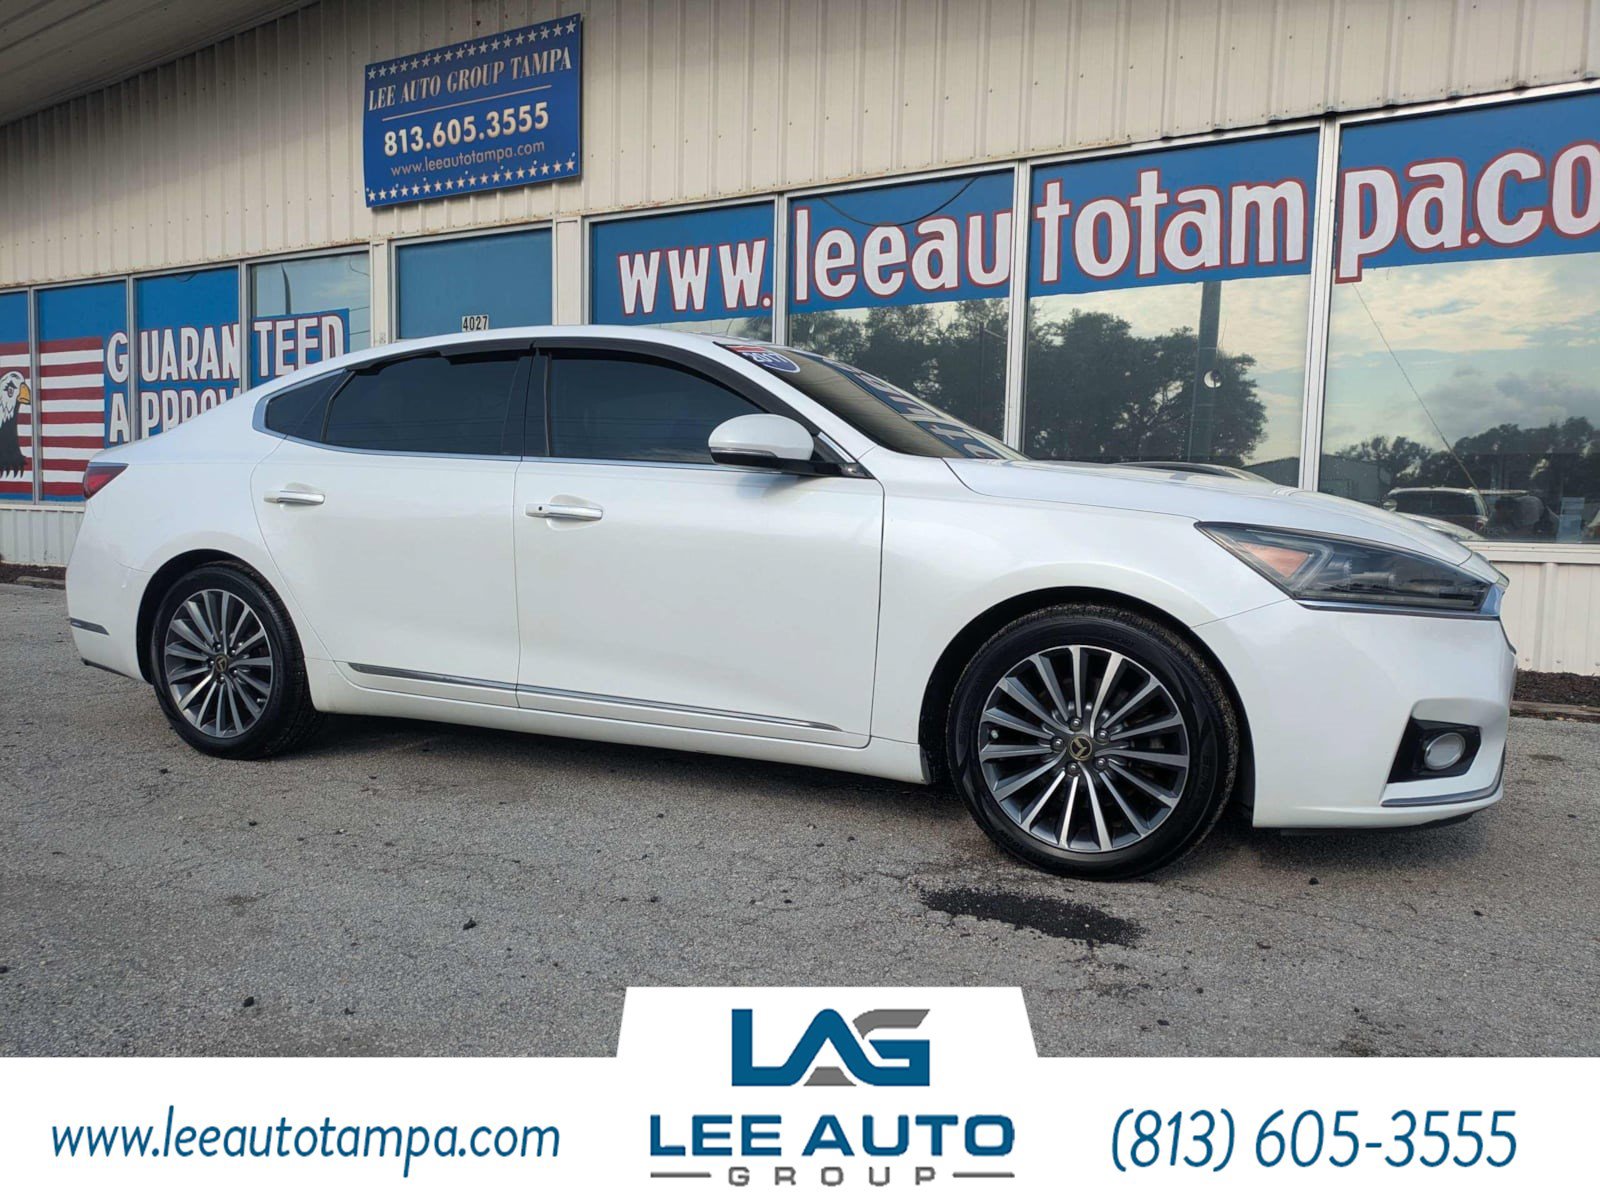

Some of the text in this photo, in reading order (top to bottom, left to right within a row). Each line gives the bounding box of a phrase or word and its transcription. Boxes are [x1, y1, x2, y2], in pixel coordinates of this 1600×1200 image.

[368, 46, 572, 111] LEE AUTO GROUP TAMPA
[383, 101, 550, 157] 813.605.3555
[390, 140, 546, 177] www.leeautotampa.com
[462, 315, 488, 331] 4027
[108, 387, 242, 443] APPR
